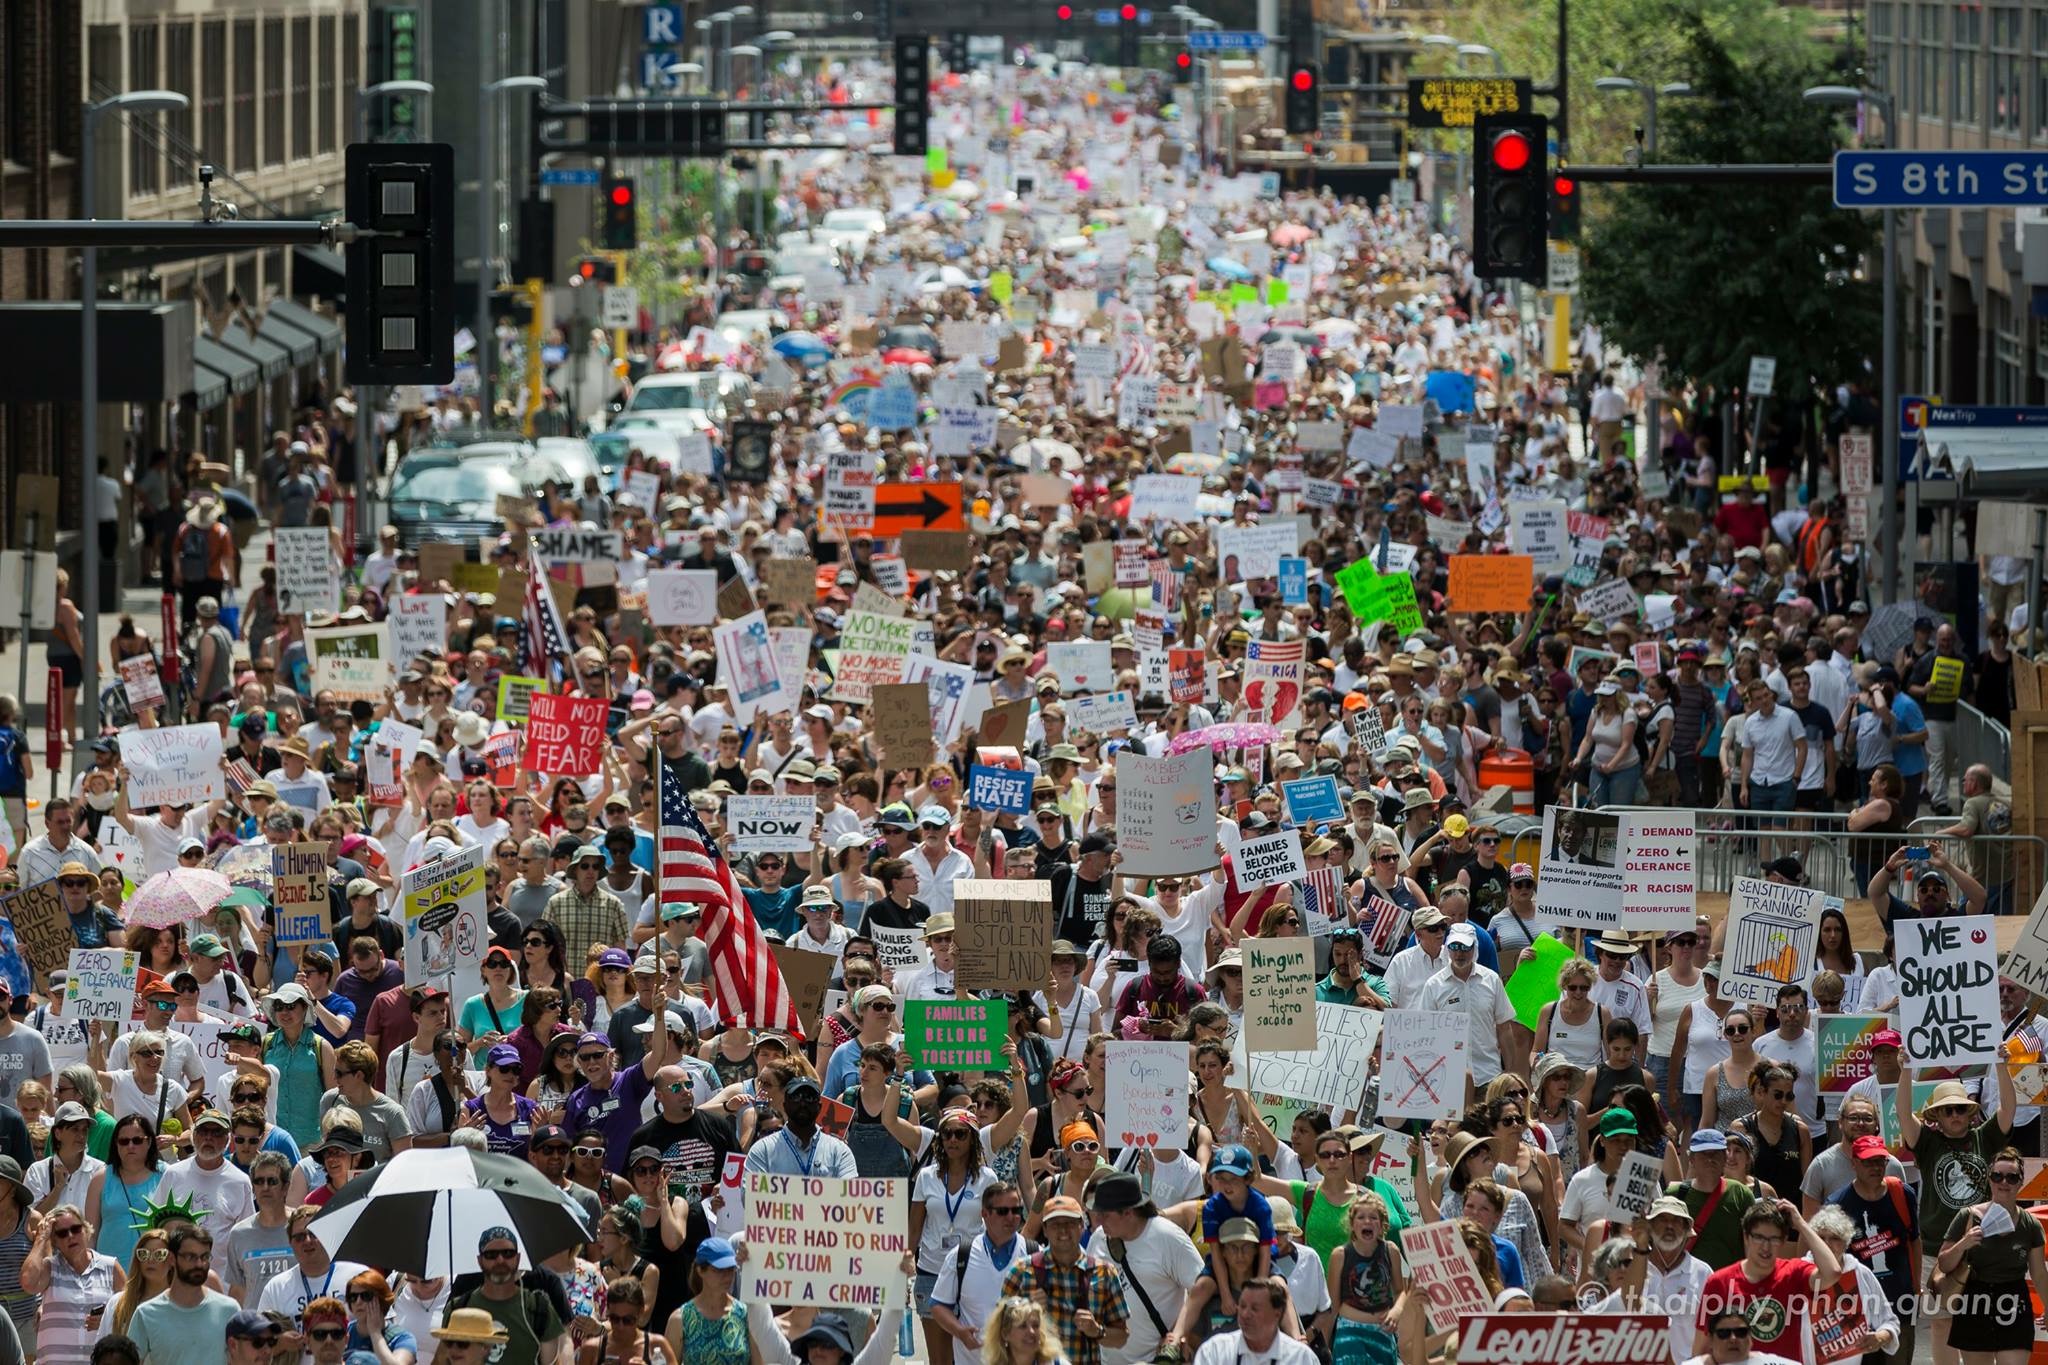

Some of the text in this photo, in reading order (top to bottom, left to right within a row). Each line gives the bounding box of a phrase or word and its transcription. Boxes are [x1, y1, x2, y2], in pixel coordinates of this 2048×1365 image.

[1853, 163, 1878, 195] S
[1902, 163, 1978, 195] 8th
[1931, 408, 1977, 423] NexTrip
[846, 613, 876, 635] NO
[1169, 668, 1191, 681] FREE
[530, 700, 605, 725] WILL NOT
[530, 723, 601, 747] YIELD TO
[1356, 720, 1383, 734] MORE
[1358, 729, 1386, 742] THAN
[536, 746, 593, 773] FEAR
[1134, 760, 1188, 774] AMBER
[133, 767, 207, 788] With Their
[974, 774, 1026, 794] RESIST
[1143, 774, 1181, 785] ALERT
[973, 789, 1024, 809] HATE
[738, 820, 802, 835] NOW
[1642, 826, 1694, 837] DEMAND
[1239, 838, 1289, 859] FAMILIES
[1636, 847, 1670, 858] ZERO
[272, 848, 327, 876] NO HUMAN
[1244, 851, 1289, 872] BELONG
[1625, 862, 1692, 873] OLERANCE
[427, 861, 474, 889] STATE RUN MEDIA
[1241, 861, 1298, 884] TOGETHER
[1540, 864, 1624, 882] Jason Lewis supports
[277, 875, 325, 905] BEING IS
[963, 882, 1051, 898] NO ONE IS
[1540, 875, 1624, 892] separation of families
[1624, 883, 1694, 894] OR RACISM
[1738, 880, 1815, 903] SENSITIVITY
[5, 884, 51, 914] FUCK
[1084, 903, 1102, 913] ERES
[1622, 905, 1692, 913] REEOURFUTURE
[1742, 895, 1807, 919] TRAINING:
[964, 897, 1044, 924] ILLEGAL ON
[1537, 904, 1617, 922] SHAME ON HIM
[16, 917, 56, 945] VOTE
[274, 906, 332, 941] ILLEGAL.
[27, 926, 73, 954] URIOUSLY
[973, 924, 1044, 948] STOLEN
[1916, 920, 1962, 957] WE
[75, 950, 112, 972] ZERO
[996, 946, 1047, 982] LAND
[1250, 949, 1305, 977] Ningun
[79, 971, 136, 991] TOLERANCE
[1251, 971, 1313, 985] ser humano
[1899, 956, 1995, 998] SHOULD
[1249, 984, 1308, 1000] es ilegal en
[1721, 979, 1757, 999] CAGE
[926, 1006, 987, 1021] FAMILIES
[1268, 1001, 1302, 1016] tierra
[1921, 994, 1978, 1027] ALL
[1389, 1013, 1451, 1030] Melt ICE
[925, 1027, 988, 1043] BELONG
[1823, 1033, 1850, 1046] ALL
[1852, 1033, 1874, 1046] AR
[1906, 1022, 1996, 1060] CARE
[11, 1053, 24, 1062] TO
[922, 1049, 992, 1065] TOGETHER
[1823, 1049, 1874, 1061] WELCOM
[1823, 1063, 1867, 1078] HERE
[1249, 1055, 1360, 1109] TOGETHER
[751, 1174, 895, 1198] EASY TO JUDGE
[756, 1201, 885, 1225] WHEN YOU'VE
[746, 1225, 797, 1245] NEVER
[804, 1229, 838, 1247] HAD
[844, 1231, 865, 1249] TO
[1404, 1225, 1455, 1258] WHAT IF
[1855, 1231, 1889, 1250] WE ARE ALL
[764, 1252, 863, 1275] ASYLUM IS
[1412, 1254, 1471, 1283] THEY TOOK
[755, 1278, 886, 1305] NOT A CRIME!
[1811, 1309, 1845, 1336] FREE
[1816, 1324, 1844, 1345] OUR
[1820, 1321, 1872, 1357] FUTURE
